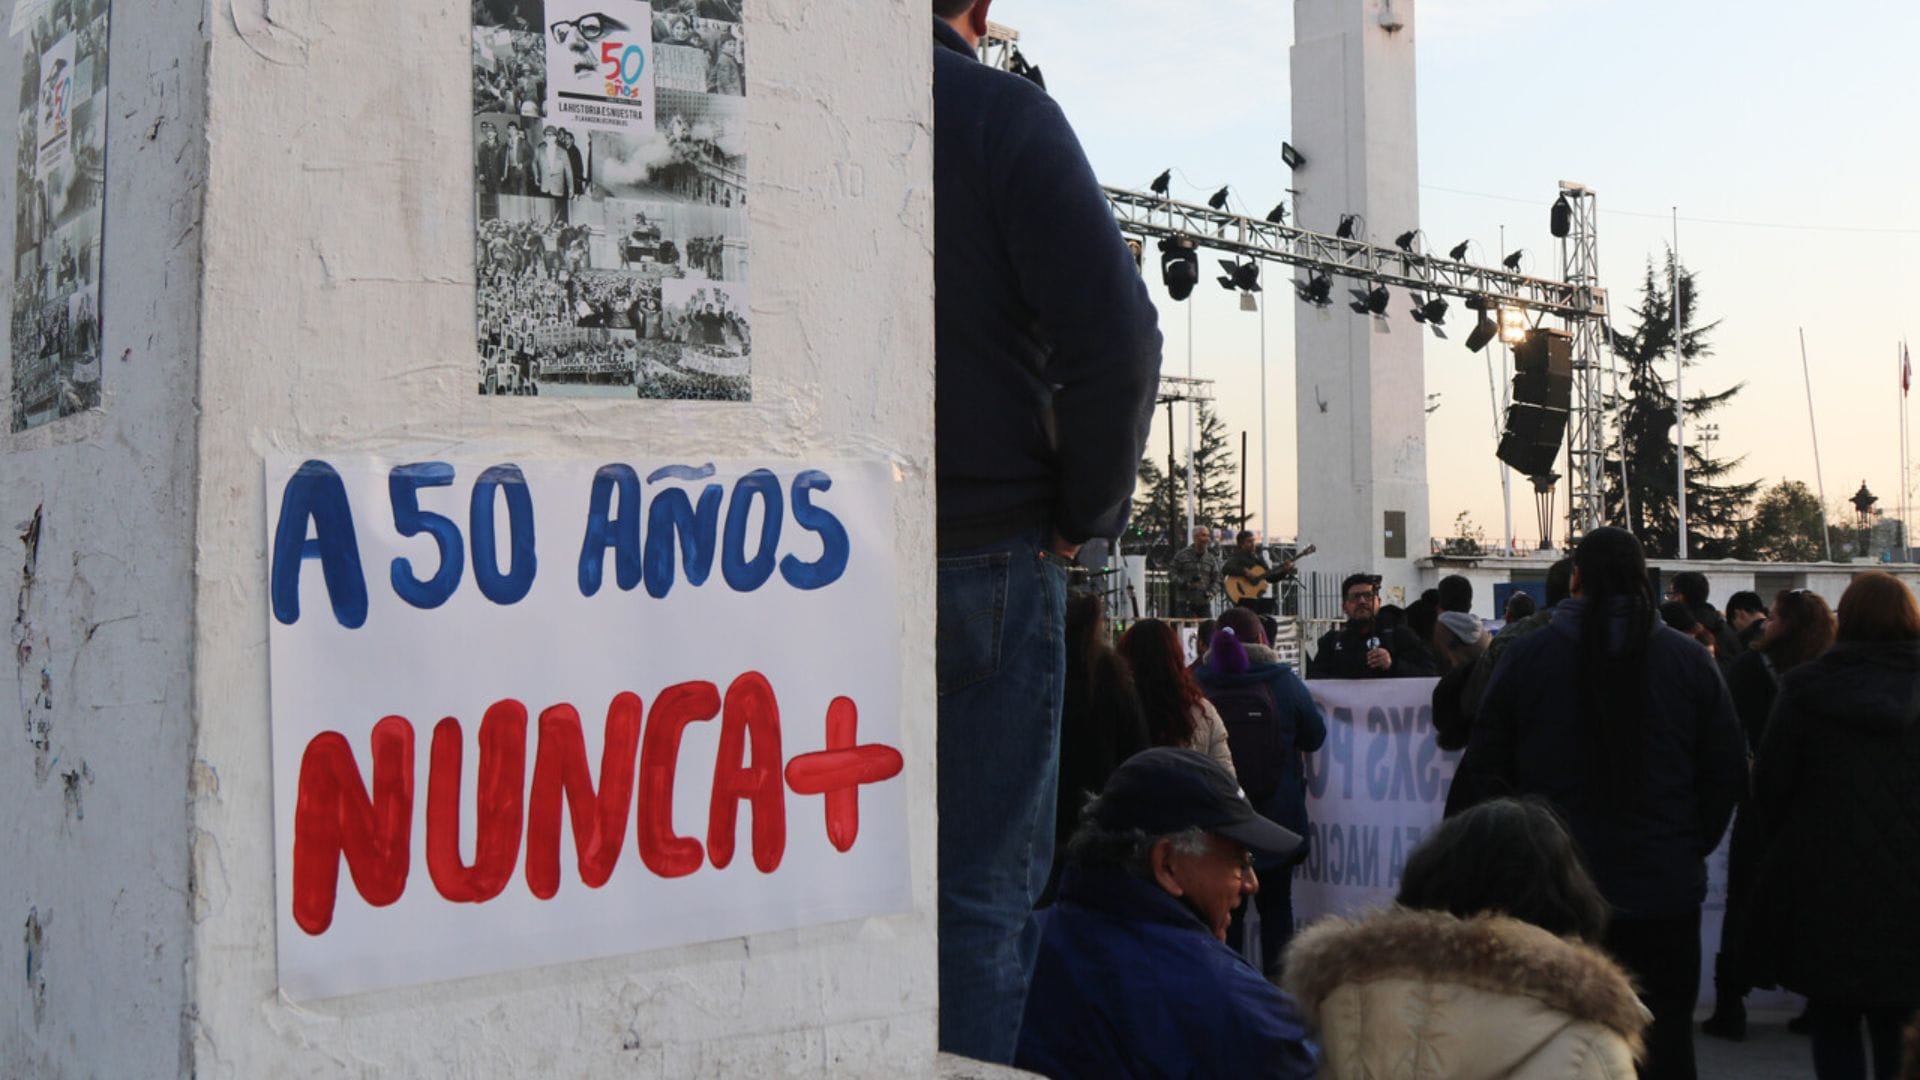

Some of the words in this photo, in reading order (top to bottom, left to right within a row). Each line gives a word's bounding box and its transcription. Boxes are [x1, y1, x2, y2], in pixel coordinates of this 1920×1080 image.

[601, 42, 645, 85] 50
[605, 80, 639, 98] años
[272, 459, 368, 629] A
[389, 461, 537, 609] 50
[578, 462, 850, 600] AÑOS
